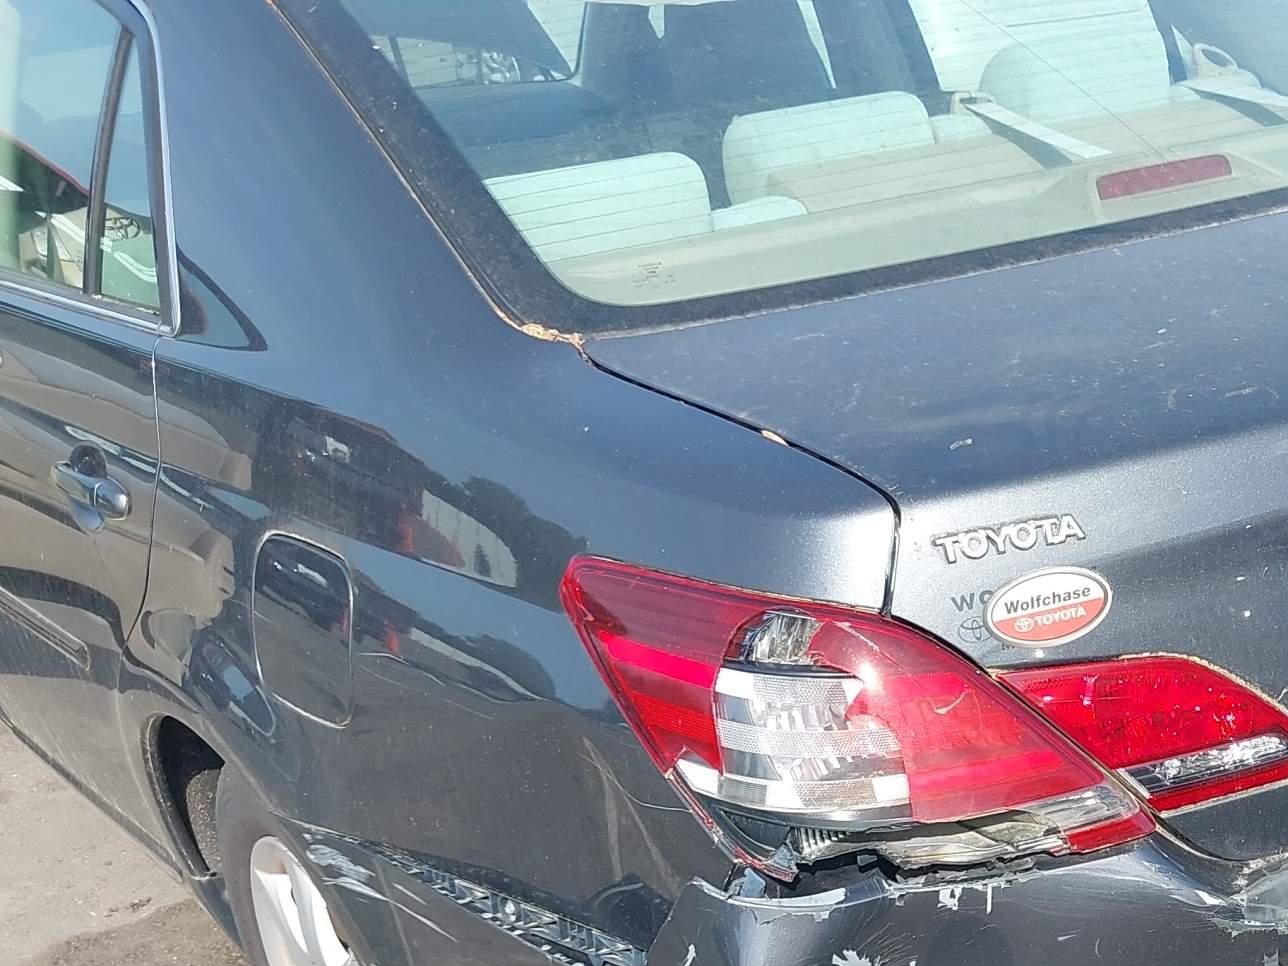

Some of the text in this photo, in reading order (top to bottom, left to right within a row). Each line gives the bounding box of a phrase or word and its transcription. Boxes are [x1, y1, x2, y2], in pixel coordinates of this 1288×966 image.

[933, 514, 1086, 563] TOYOTA
[1004, 587, 1091, 614] Wolfchase
[1034, 606, 1087, 627] TOYOTA
